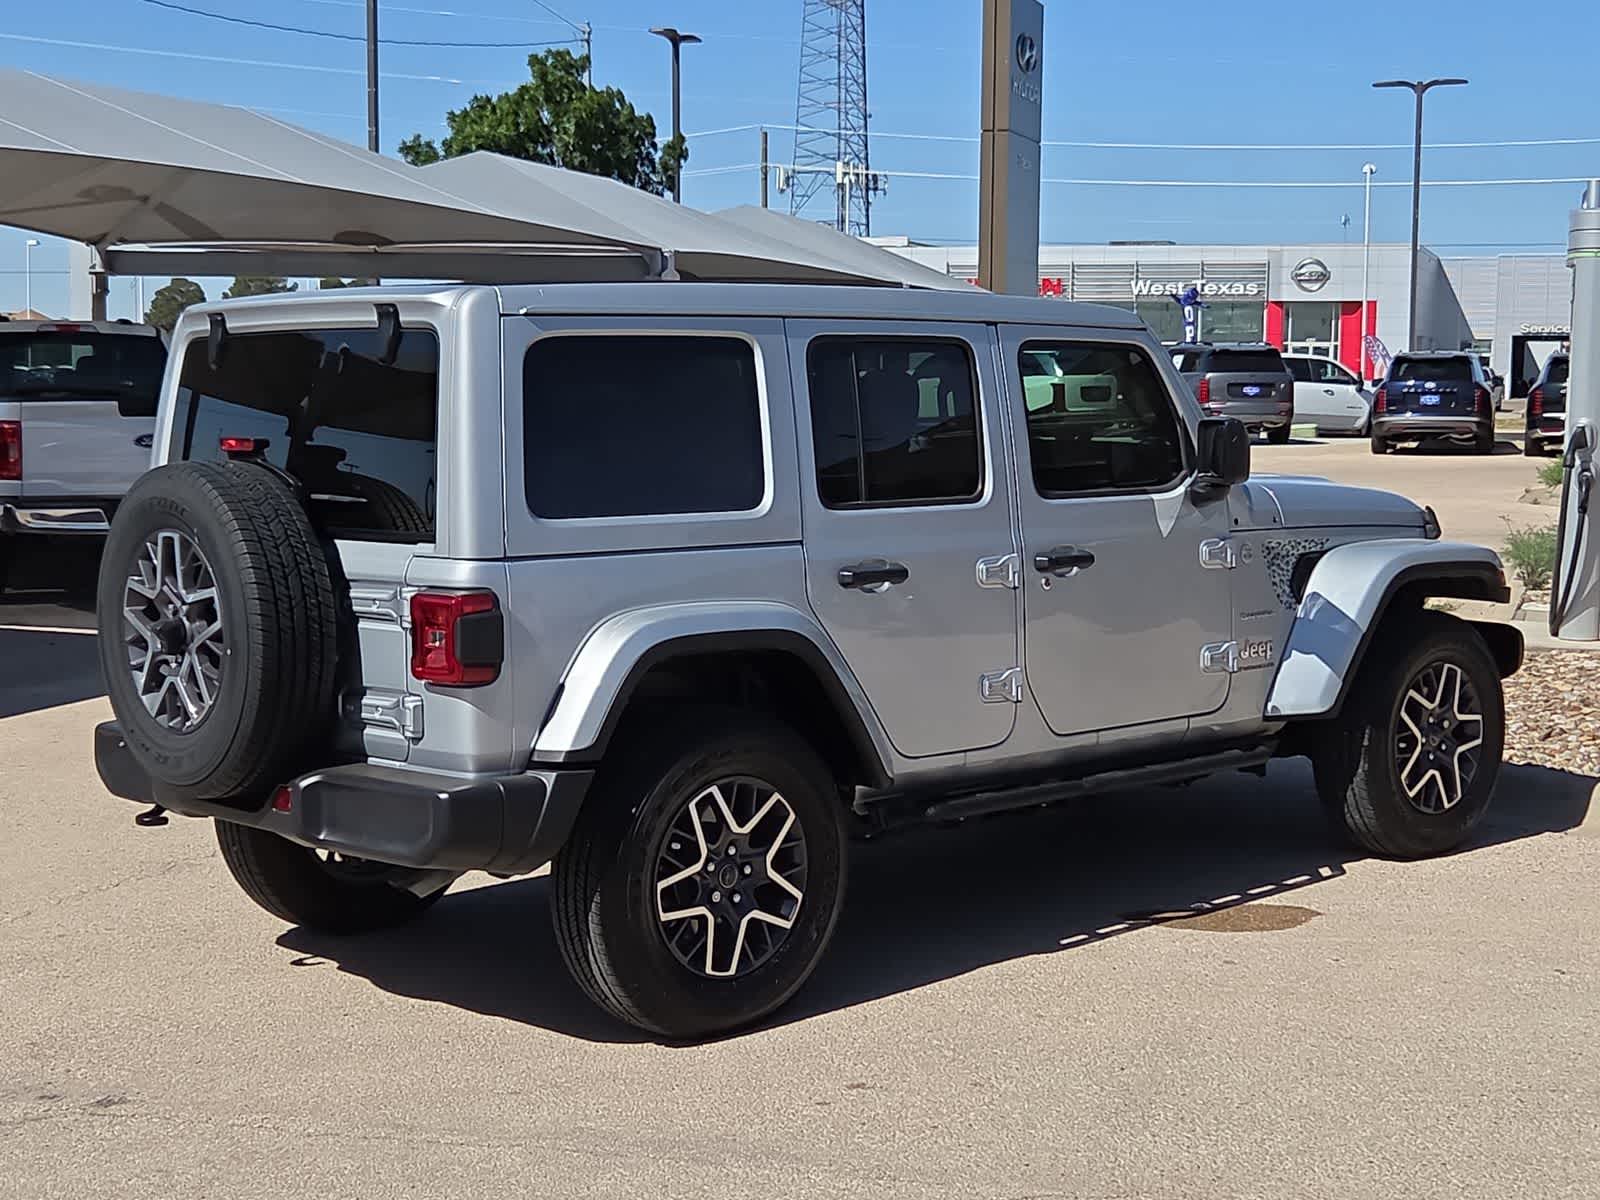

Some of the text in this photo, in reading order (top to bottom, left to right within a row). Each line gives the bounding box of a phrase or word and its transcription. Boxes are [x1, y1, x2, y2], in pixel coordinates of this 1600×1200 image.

[1131, 279, 1258, 296] West Texas
[1239, 637, 1273, 660] Jeep
